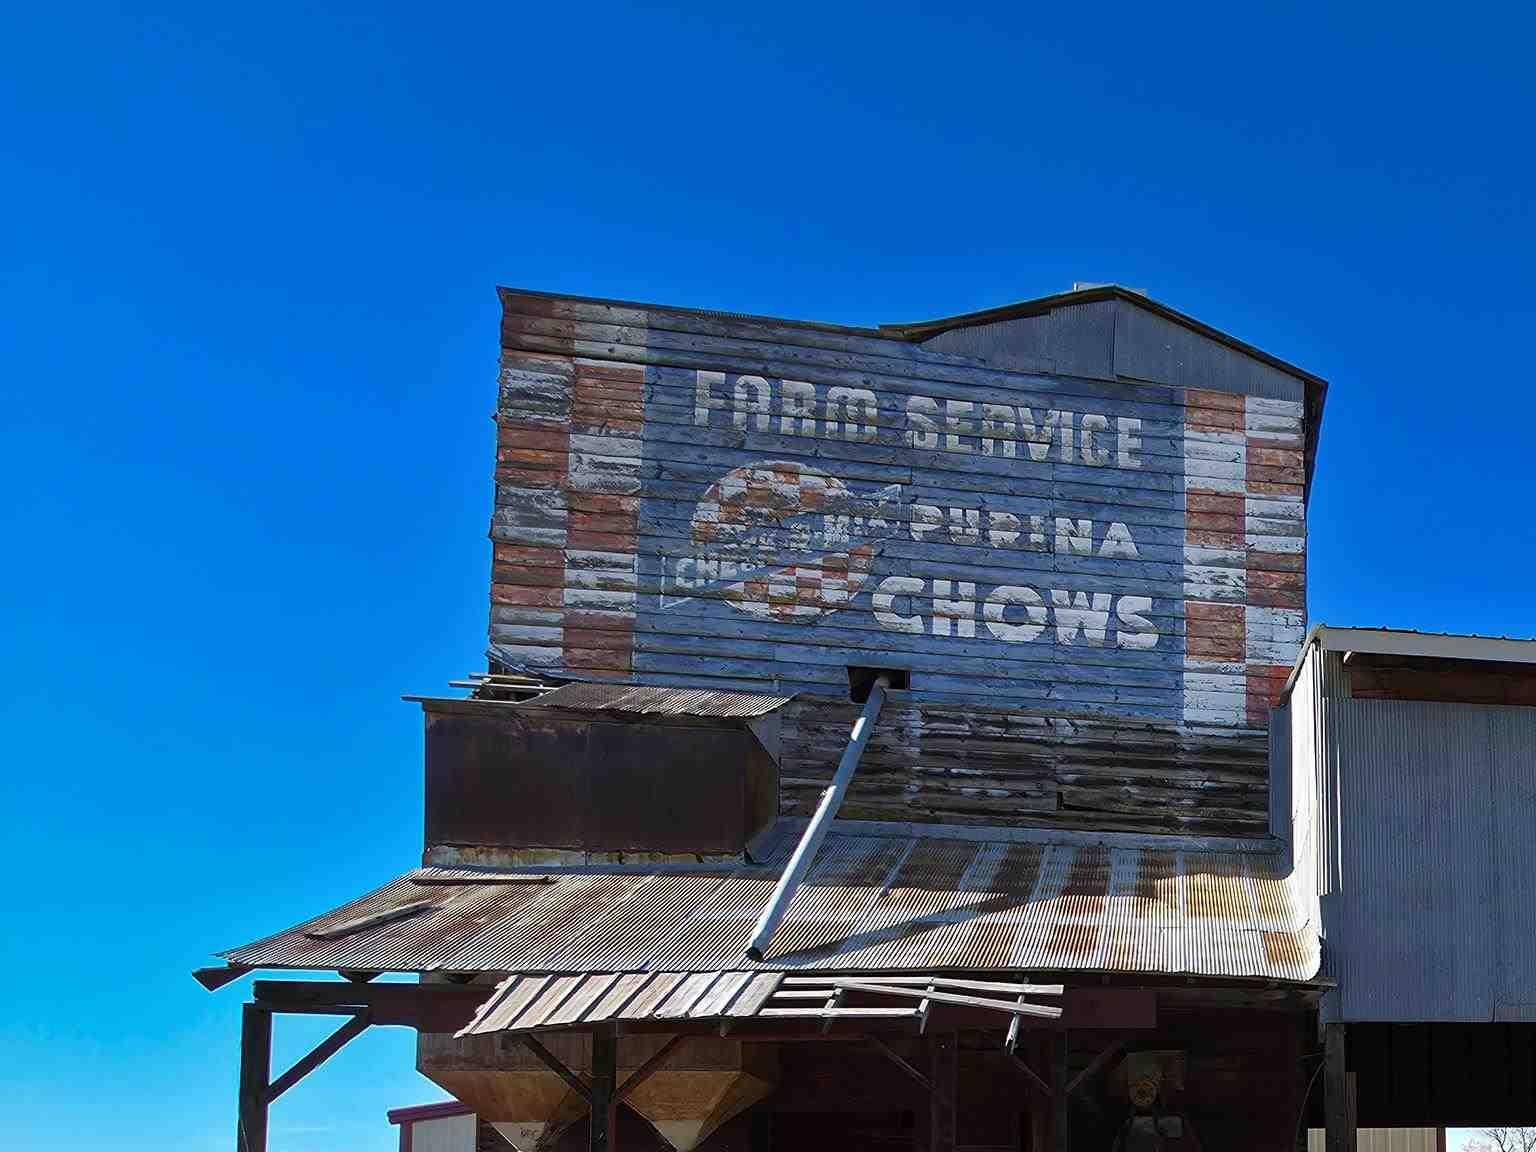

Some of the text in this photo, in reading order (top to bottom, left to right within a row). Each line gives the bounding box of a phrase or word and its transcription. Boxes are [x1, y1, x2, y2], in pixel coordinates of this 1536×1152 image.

[695, 371, 1143, 468] FARM SERVICE
[910, 504, 1138, 559] PURINA
[872, 576, 1160, 649] CHOWS
